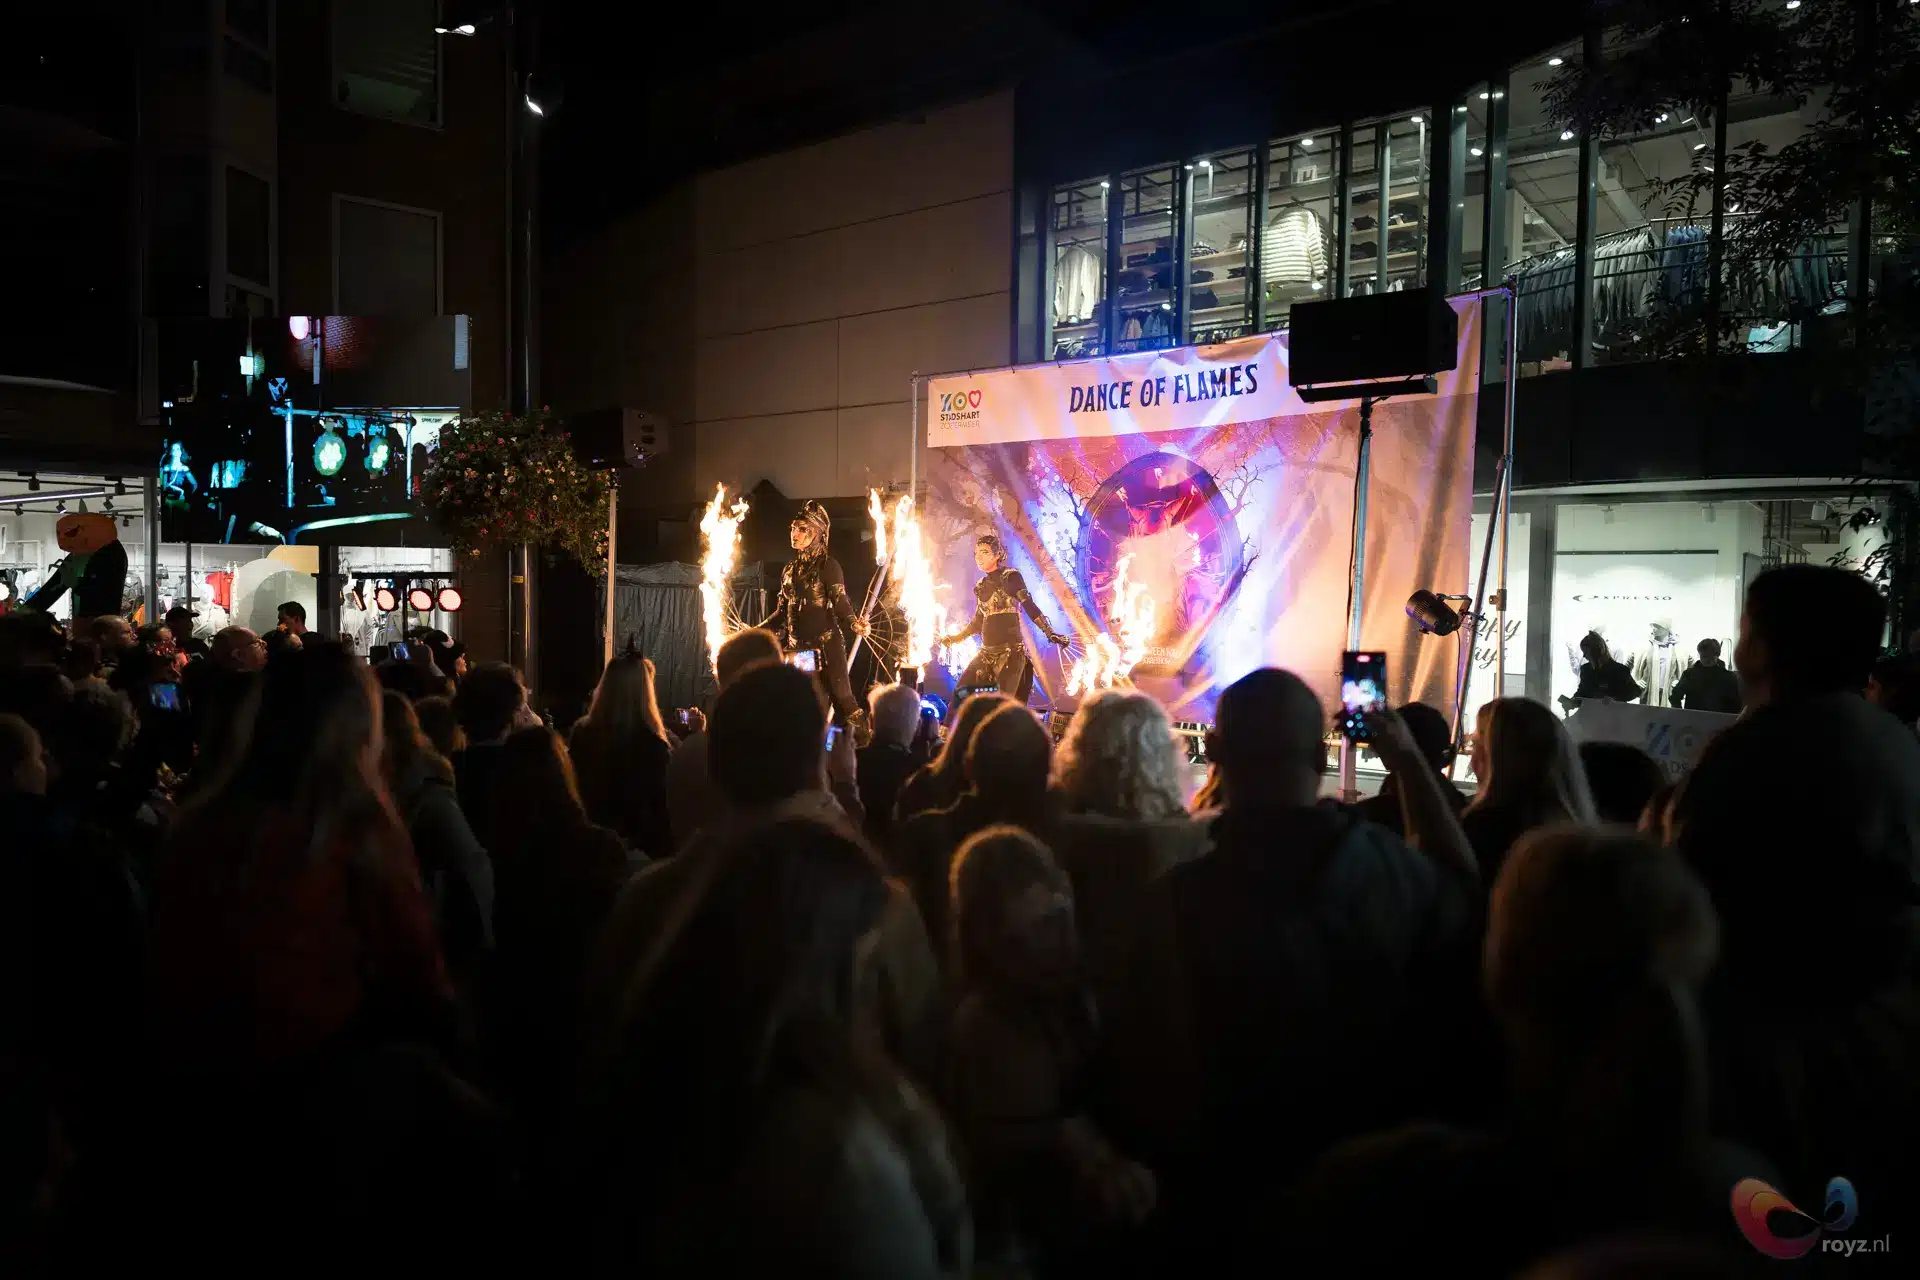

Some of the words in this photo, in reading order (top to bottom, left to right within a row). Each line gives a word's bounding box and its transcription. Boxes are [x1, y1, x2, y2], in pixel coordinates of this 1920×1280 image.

[1069, 381, 1133, 413] DANCE
[1140, 376, 1166, 407] OF
[1173, 363, 1258, 404] FLAMES
